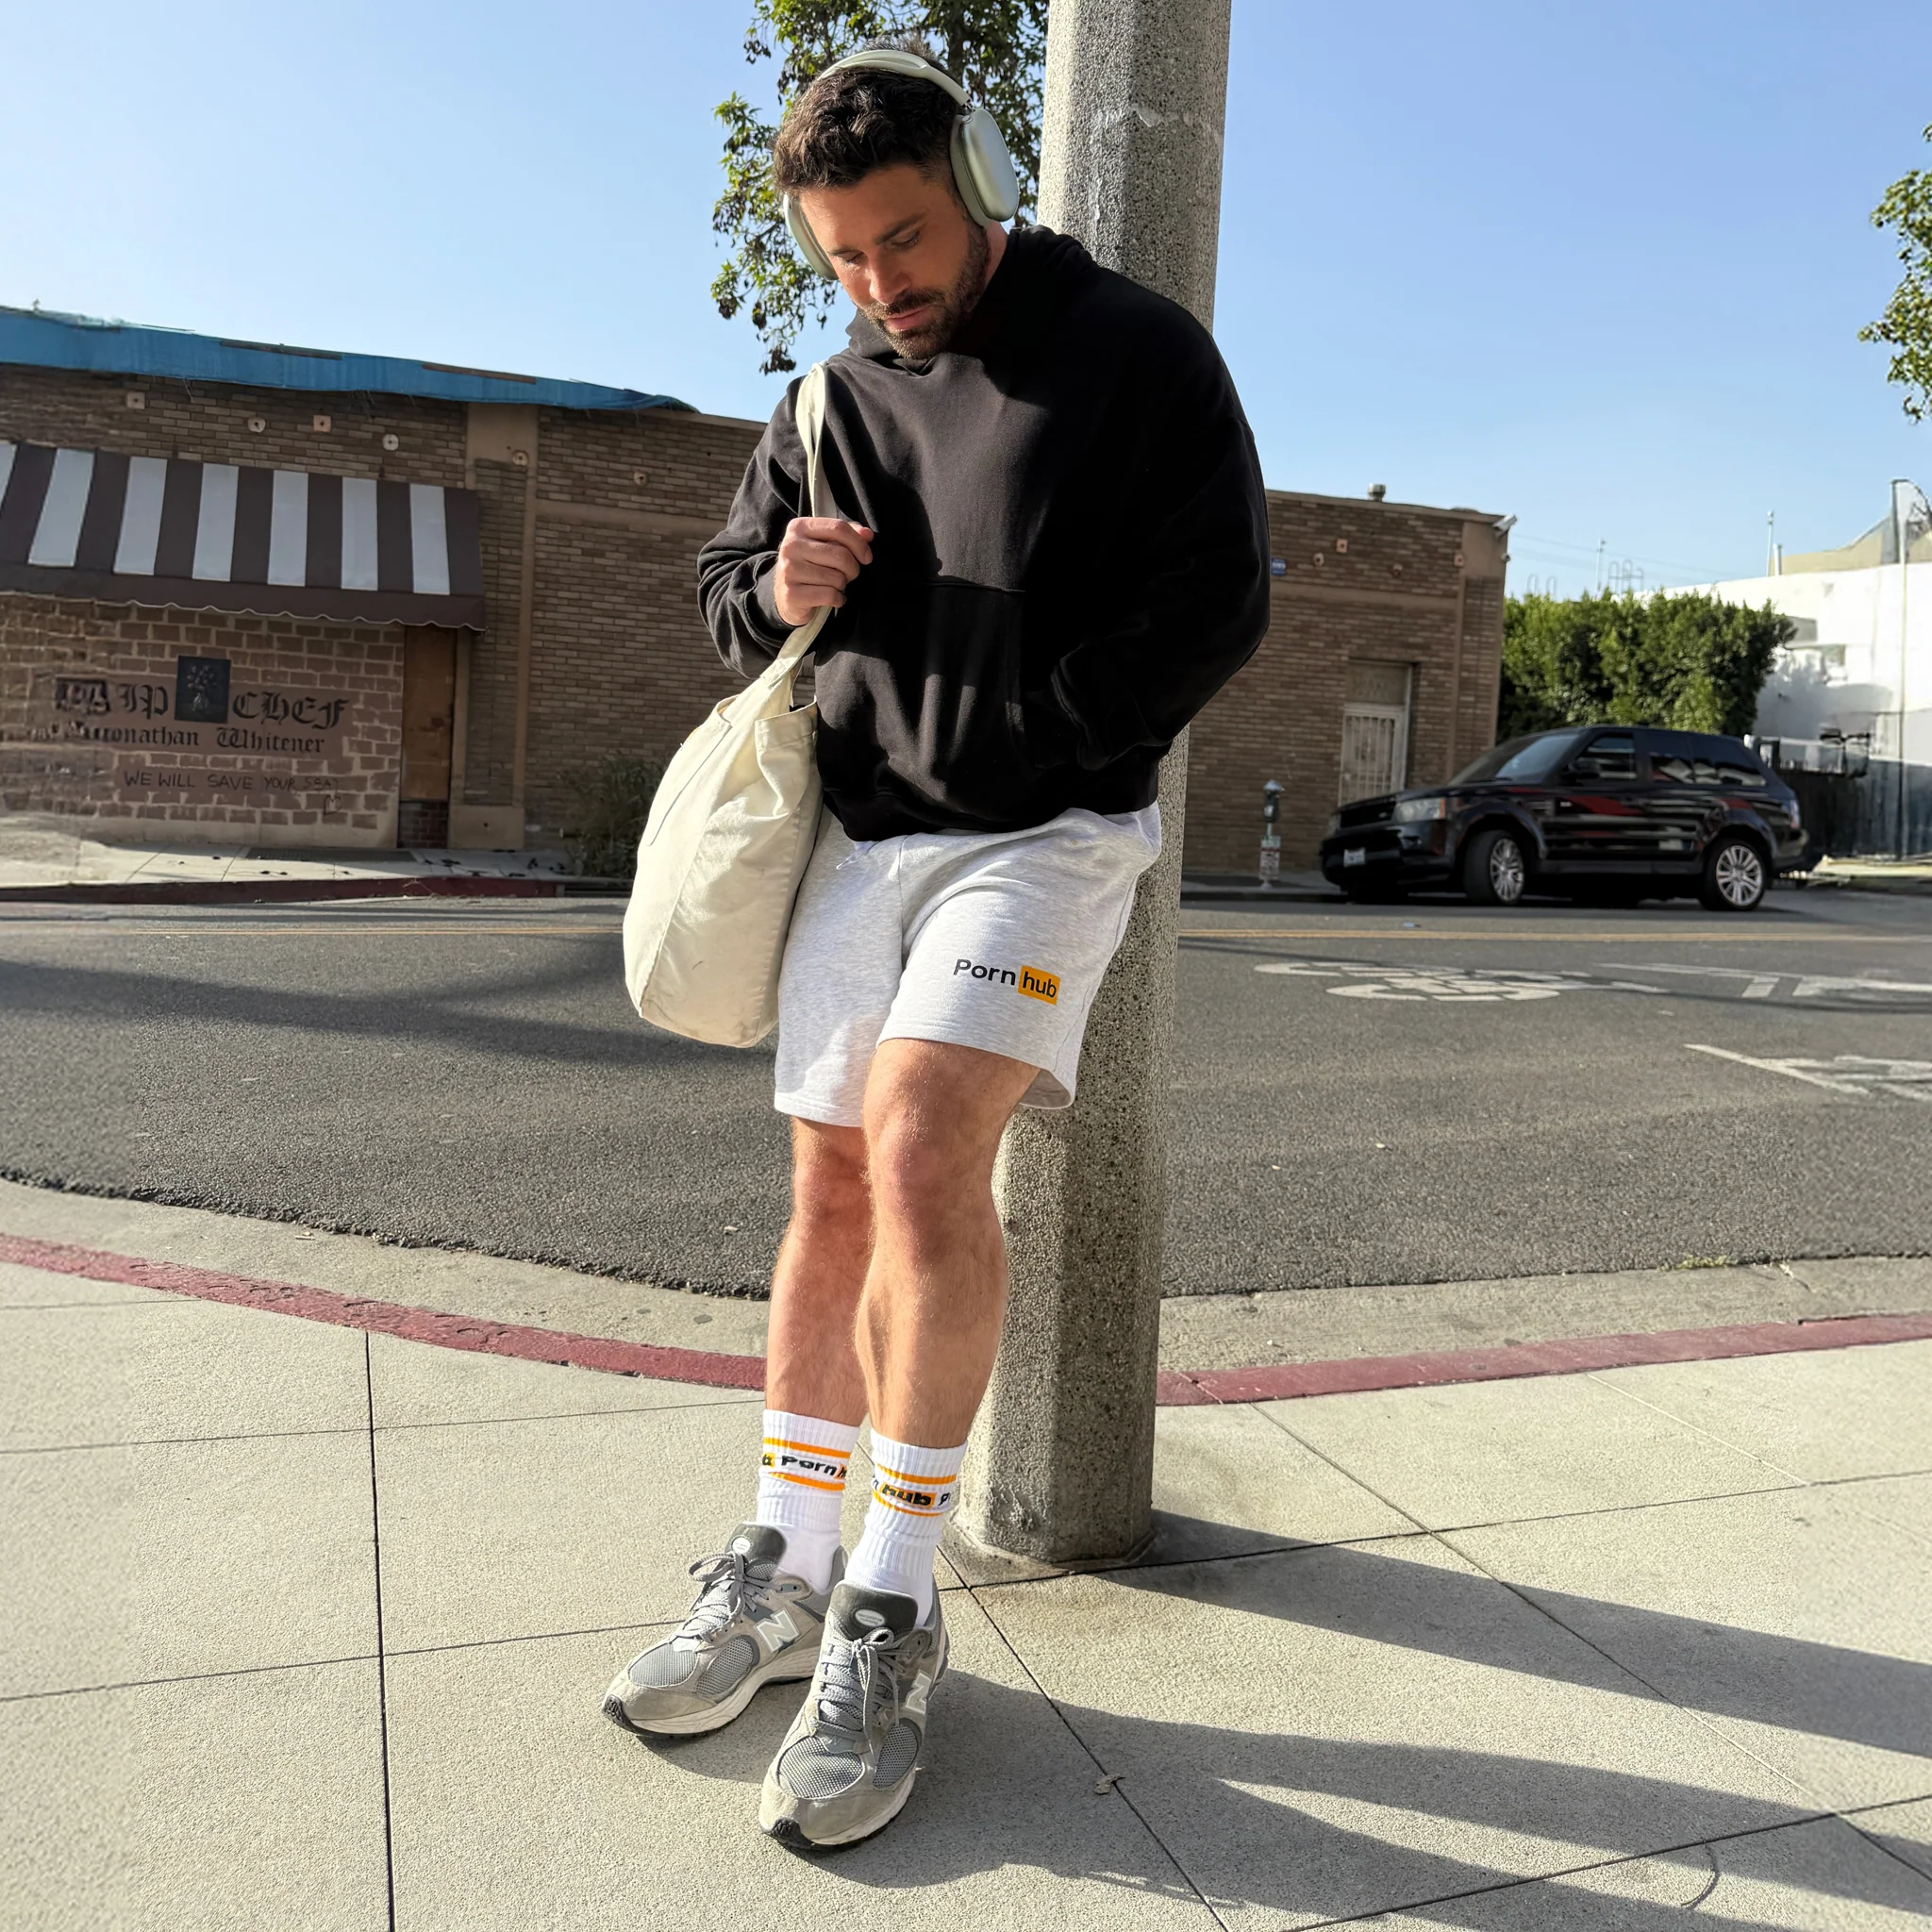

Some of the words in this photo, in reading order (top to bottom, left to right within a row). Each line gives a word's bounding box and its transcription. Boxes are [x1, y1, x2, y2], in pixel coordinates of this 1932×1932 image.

[216, 726, 325, 754] Whitener
[124, 770, 153, 788] WE
[158, 772, 196, 789] WILL
[207, 773, 254, 791] SAVE
[263, 775, 296, 791] YOUR
